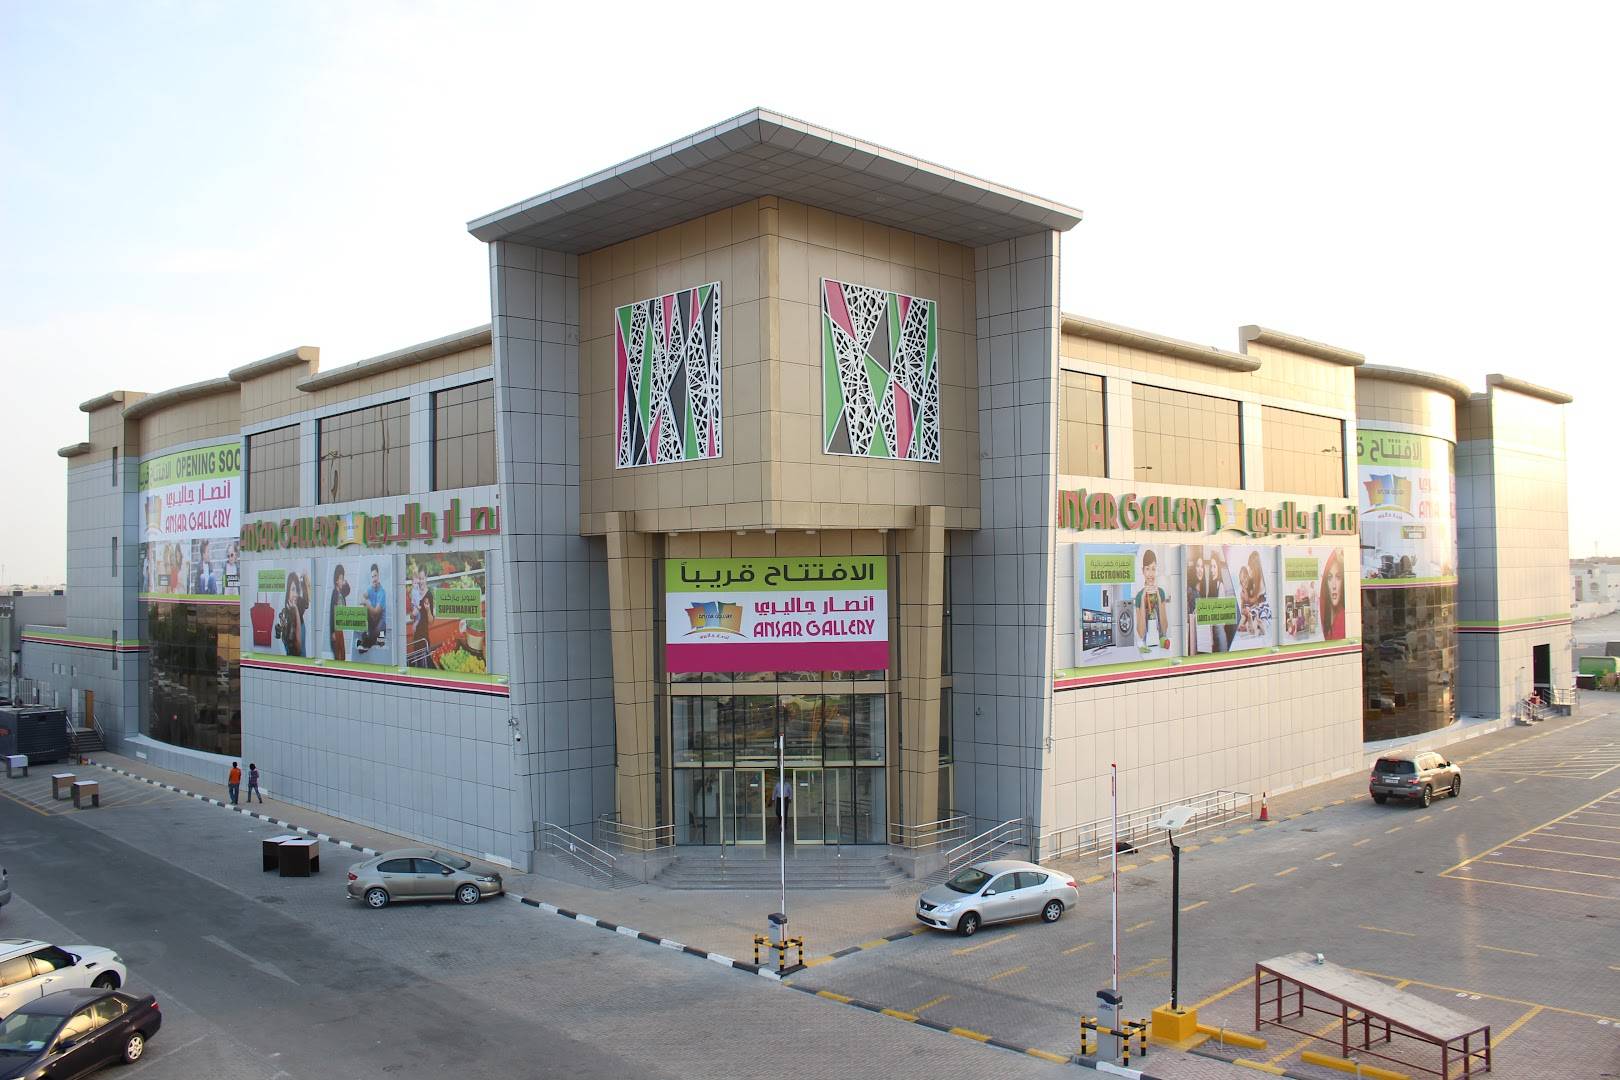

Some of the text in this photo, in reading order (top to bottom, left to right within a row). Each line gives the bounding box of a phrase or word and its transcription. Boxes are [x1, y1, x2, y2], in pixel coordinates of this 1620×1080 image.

[176, 451, 216, 479] OPENING
[165, 507, 232, 534] ANSAR GALLERY
[1119, 493, 1209, 532] GALLERY
[240, 515, 340, 552] ANSAR GALLERY
[764, 563, 874, 586] الافتتاح
[1090, 570, 1131, 580] ELECTRONICS
[438, 604, 478, 615] SUPERMARKET
[754, 597, 816, 616] جاليري
[753, 619, 875, 638] ANSAR GALLERY
